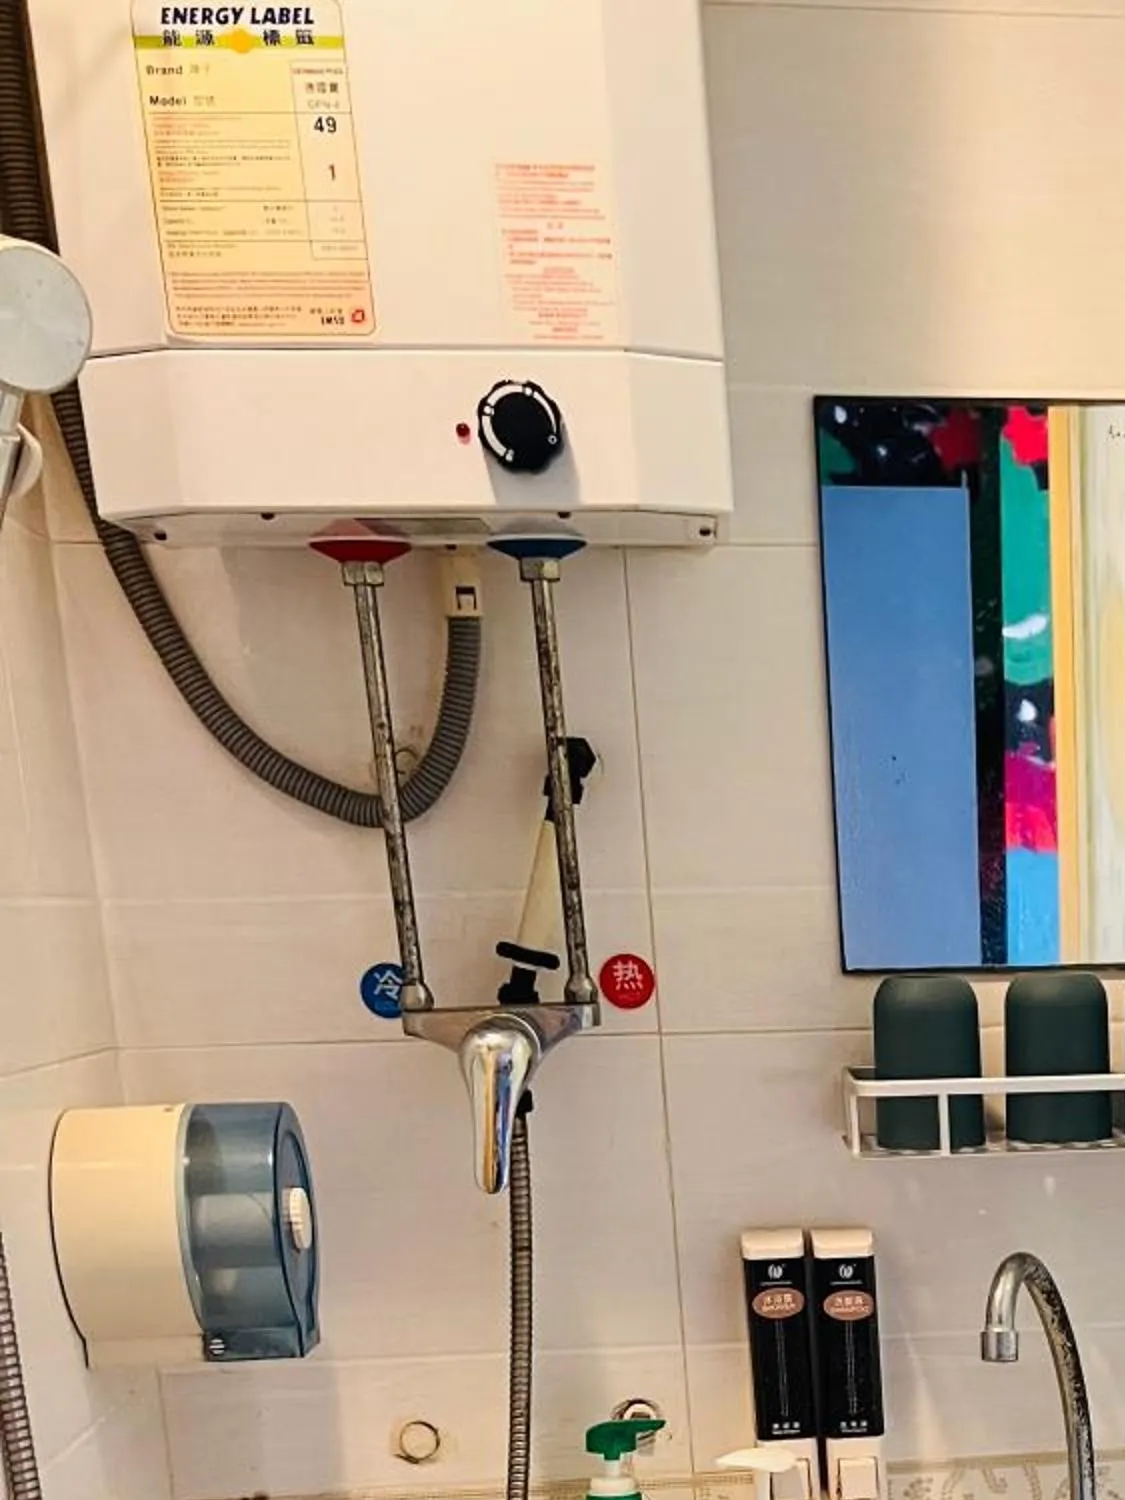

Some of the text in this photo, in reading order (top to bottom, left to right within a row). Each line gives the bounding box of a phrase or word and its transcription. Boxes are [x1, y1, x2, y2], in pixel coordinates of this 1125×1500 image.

[161, 7, 314, 25] ENERGY LABEL
[146, 65, 183, 75] Brand
[149, 96, 187, 106] Model
[314, 116, 337, 133] 49
[612, 960, 643, 990] 热
[373, 970, 402, 1000] 冷
